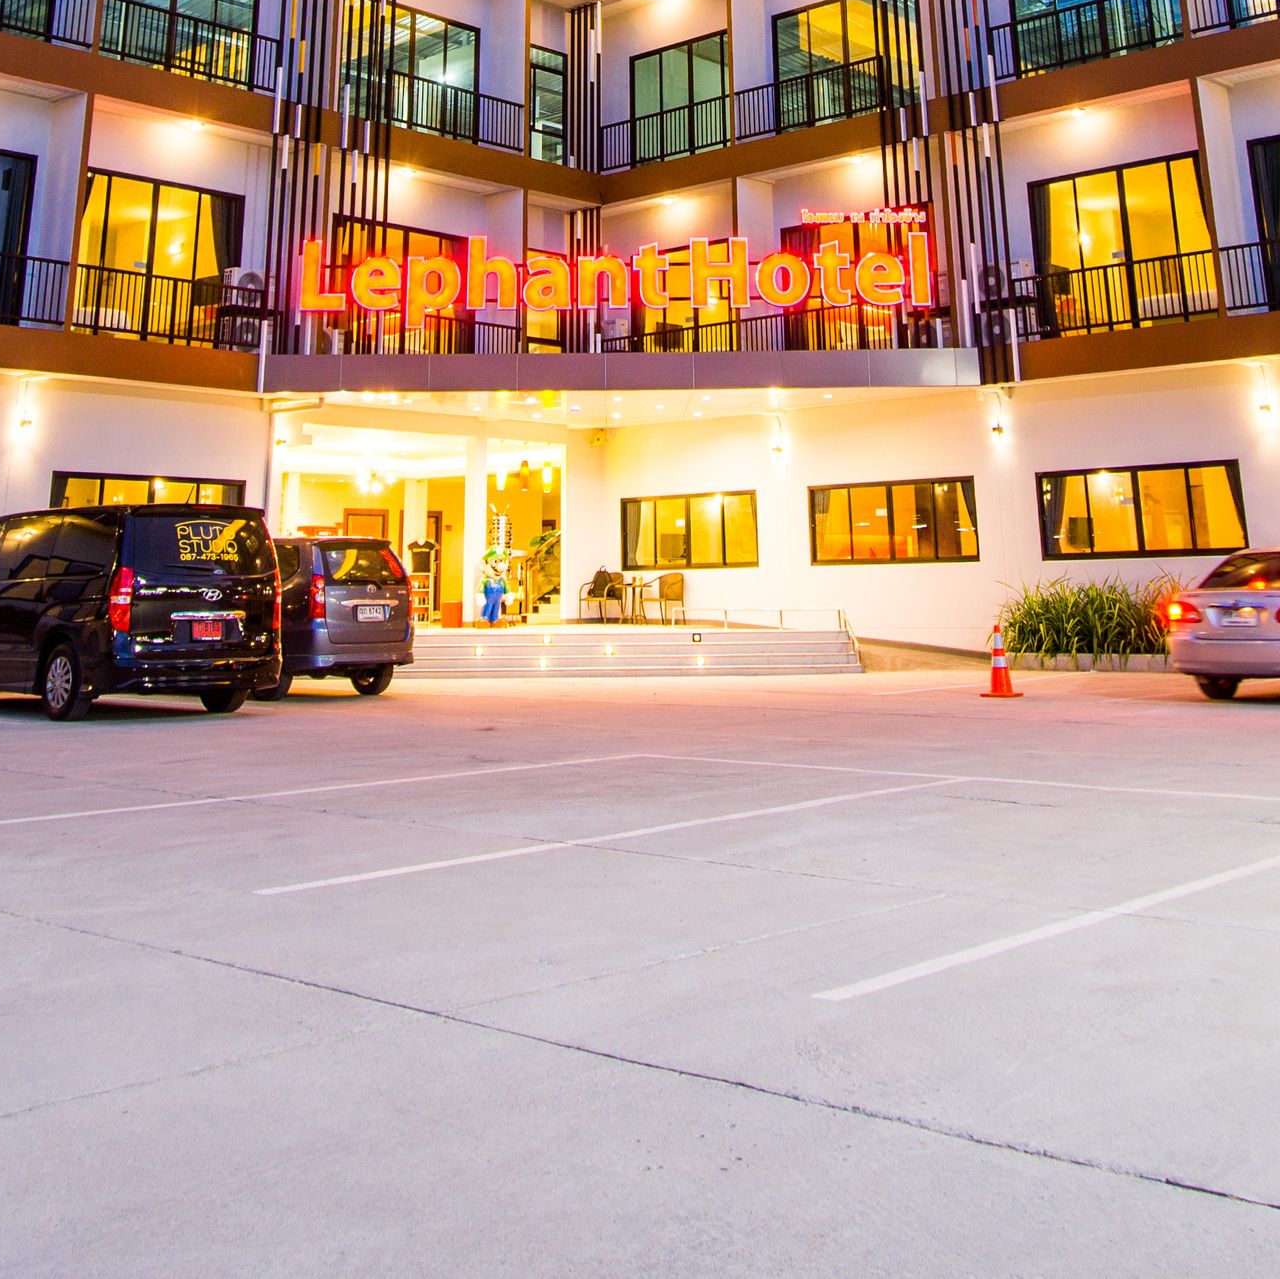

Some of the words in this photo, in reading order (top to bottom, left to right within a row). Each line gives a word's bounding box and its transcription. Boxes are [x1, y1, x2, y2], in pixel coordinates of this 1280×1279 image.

[801, 209, 844, 223] โรงแรม
[300, 236, 669, 329] Lephant
[689, 232, 932, 309] Hotel
[176, 525, 236, 540] PLUTO
[178, 540, 238, 553] STUDIO
[180, 553, 239, 561] 087-473-1965
